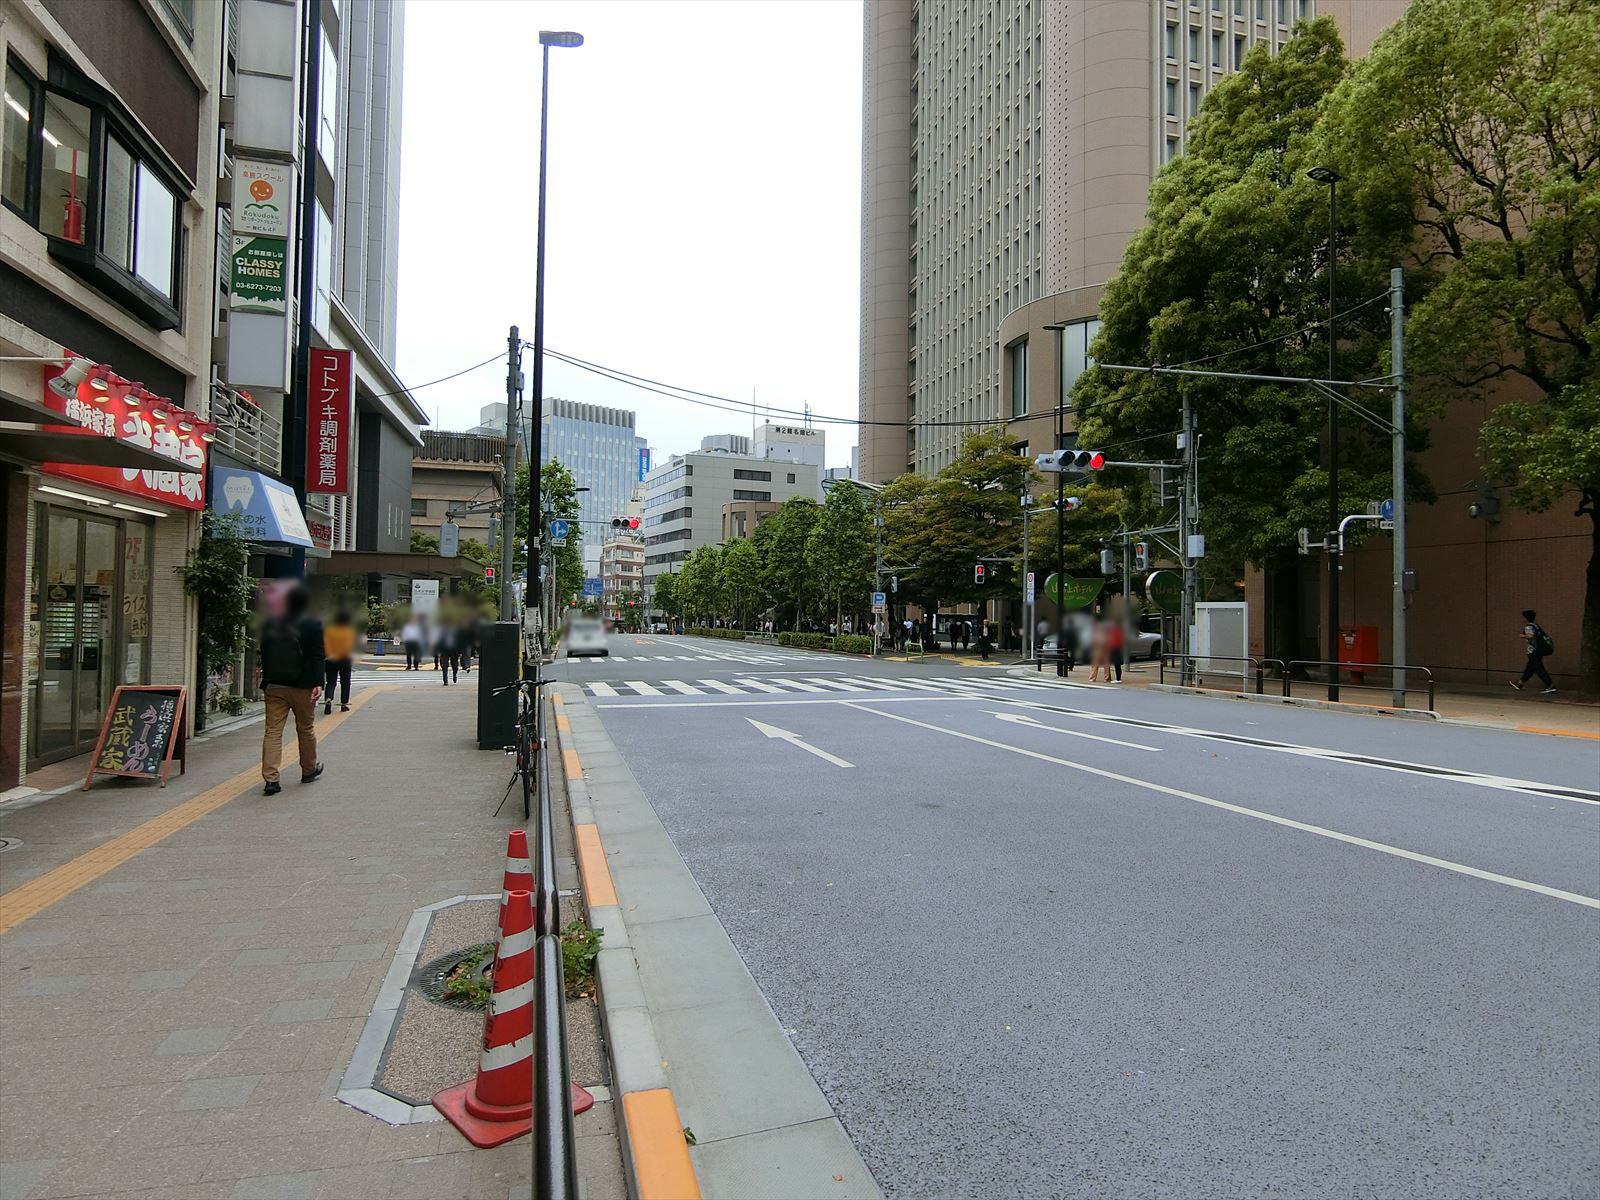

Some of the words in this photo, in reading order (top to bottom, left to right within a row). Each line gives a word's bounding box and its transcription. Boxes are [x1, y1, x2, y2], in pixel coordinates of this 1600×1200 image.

[235, 257, 283, 269] CLASSY
[237, 266, 281, 278] HOMES
[235, 282, 282, 292] 03-6273-7203
[318, 355, 339, 487] コトブキ調剤薬局
